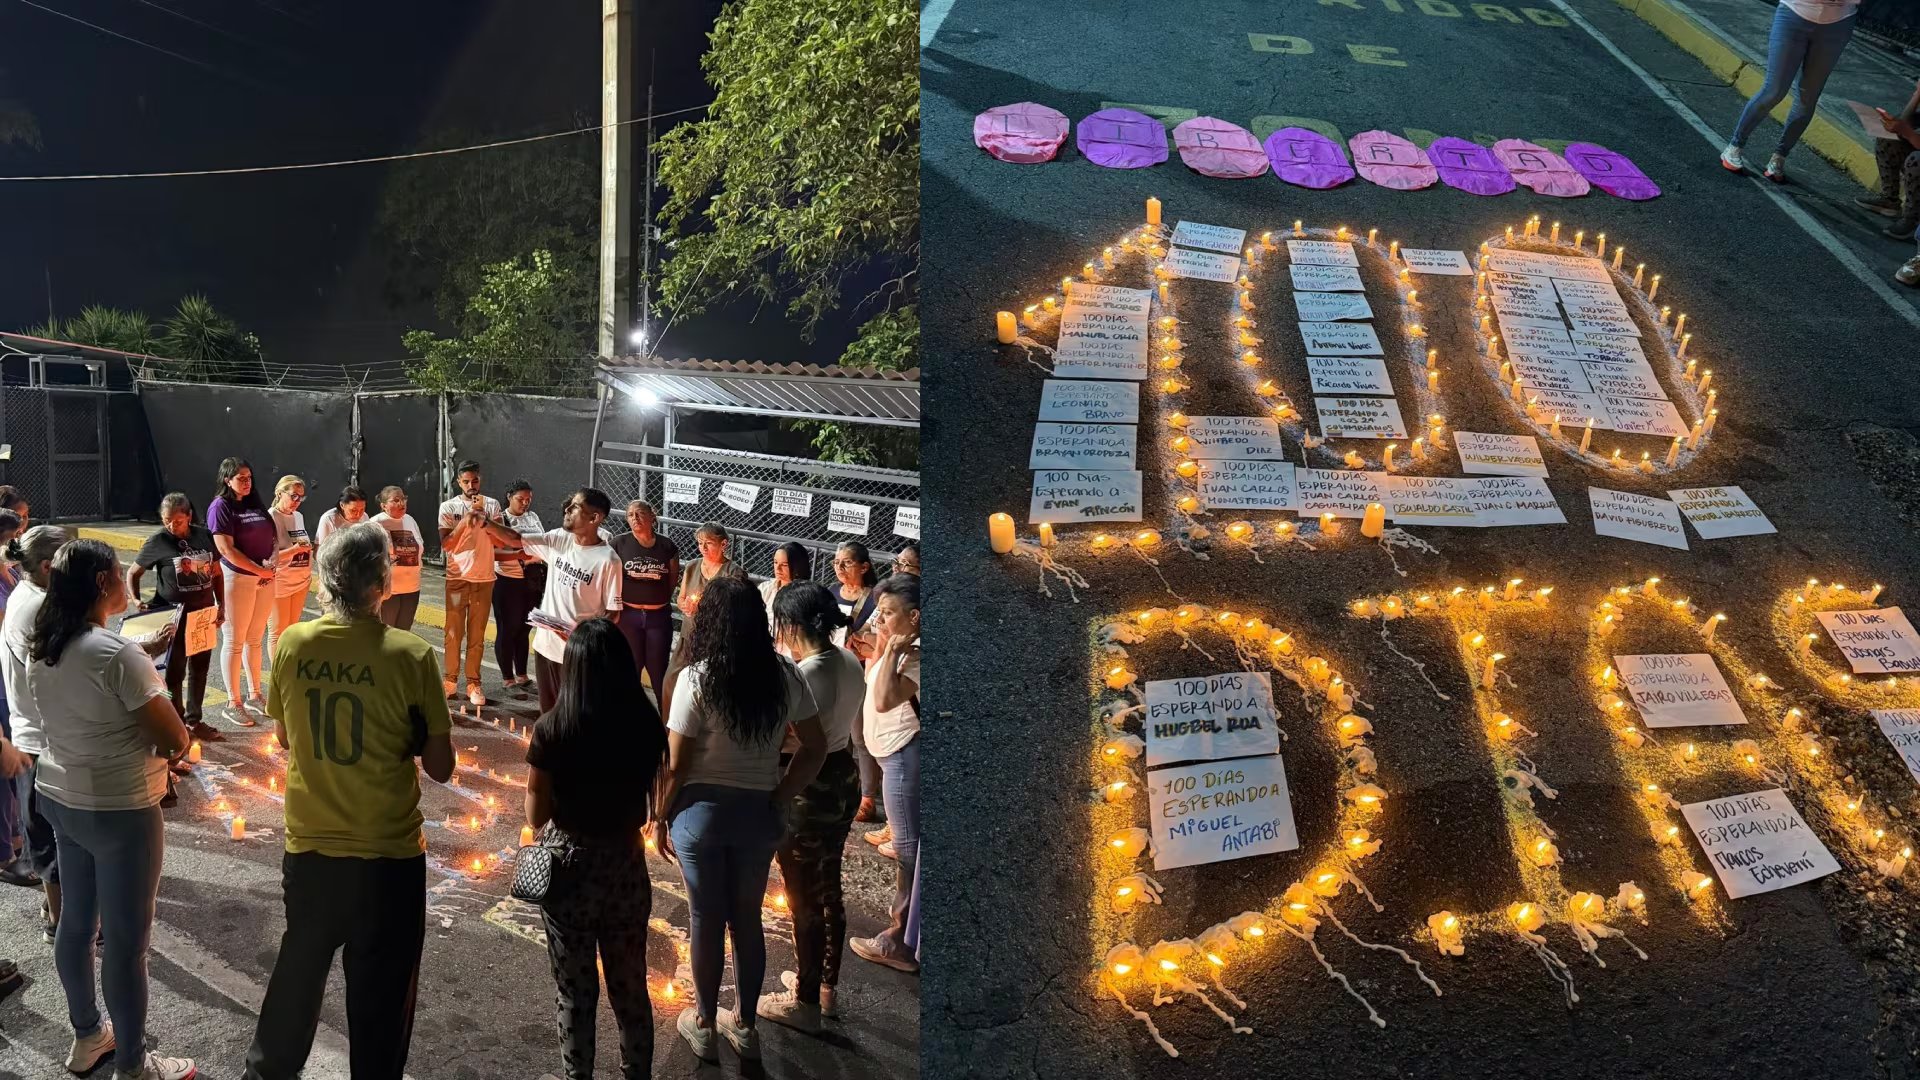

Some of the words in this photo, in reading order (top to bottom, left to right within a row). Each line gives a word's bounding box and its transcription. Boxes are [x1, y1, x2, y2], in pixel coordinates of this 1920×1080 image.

[1247, 32, 1407, 67] DE
[1003, 113, 1614, 173] LIBERTAD
[1083, 313, 1103, 322] 100
[1105, 313, 1129, 323] DÍAS
[1063, 321, 1125, 331] ESPERANDO
[1060, 330, 1110, 340] MANUEL
[1080, 341, 1100, 349] 100
[1058, 359, 1101, 367] HECTOR
[1055, 384, 1076, 392] 100
[1315, 377, 1352, 389] Ricardo
[1053, 391, 1119, 400] ESPERANDO
[1081, 409, 1125, 420] BRAVO
[1319, 408, 1379, 418] ESPERANDO
[1206, 417, 1231, 427] 100
[1059, 425, 1086, 436] 100
[1086, 425, 1117, 435] DÍAS
[1189, 428, 1259, 437] ESPERANDO
[1037, 436, 1116, 447] ESPERANDO
[1471, 432, 1494, 444] 100
[1495, 434, 1520, 445] DÍAS
[1035, 448, 1082, 458] BRAYAN
[1082, 448, 1131, 459] OROPEZA
[1246, 446, 1274, 455] DIAZ
[1458, 442, 1522, 453] ESPERANDO
[1222, 461, 1247, 472] 100
[1044, 471, 1070, 483] 100
[1200, 471, 1272, 482] ESPERANDO
[1315, 470, 1340, 481] 100
[1298, 481, 1368, 492] ESPERANDO
[1402, 477, 1424, 488] 100
[1476, 478, 1500, 490] 100
[1501, 478, 1526, 489] DÍAS
[724, 484, 751, 496] CIERREN
[789, 489, 808, 498] DÍAS
[1035, 485, 1104, 500] Esperando
[1202, 483, 1238, 494] JUAN
[1240, 483, 1290, 495] CARLOS
[1389, 489, 1463, 501] ESPERANDO
[1467, 489, 1532, 500] ESPERANDO
[1682, 489, 1706, 501] 100
[1706, 487, 1729, 499] DÍAS
[728, 494, 749, 504] RODEO
[1299, 491, 1333, 500] JUAN
[1336, 492, 1381, 502] CARLOS
[1609, 491, 1630, 503] 100
[1043, 499, 1080, 510] EVAN
[1080, 502, 1136, 517] RINCÓN
[1393, 503, 1442, 514] OSWALDO
[1473, 501, 1504, 512] JUAN
[1592, 500, 1655, 518] ESPERANDO
[1678, 499, 1735, 511] ESPERANDO
[832, 507, 845, 515] 100
[846, 509, 866, 518] DÍAS
[843, 516, 865, 525] LUCES
[1594, 511, 1624, 524] DAVID
[1625, 516, 1681, 534] FIGUEREDO
[1834, 612, 1858, 626] 100
[1831, 627, 1891, 645] Esperando
[1639, 655, 1666, 671] 100
[296, 659, 376, 687] KAKA
[1625, 672, 1699, 687] ESPERANDO
[1173, 680, 1208, 697] 100
[1210, 676, 1244, 693] DÍAS
[1150, 697, 1244, 719] ESPERANDO
[1884, 711, 1914, 728] 100
[304, 687, 365, 767] 10
[1153, 717, 1223, 740] HUGBEL
[1225, 715, 1264, 734] RUA
[1163, 775, 1197, 796] 100
[1162, 786, 1269, 819] ESPERANDO
[1705, 801, 1737, 822] 100
[1738, 795, 1772, 815] DÍAS
[1698, 817, 1787, 847] ESPERANDO
[1714, 846, 1765, 871] Marcos
[1748, 850, 1816, 885] Echeverrí
